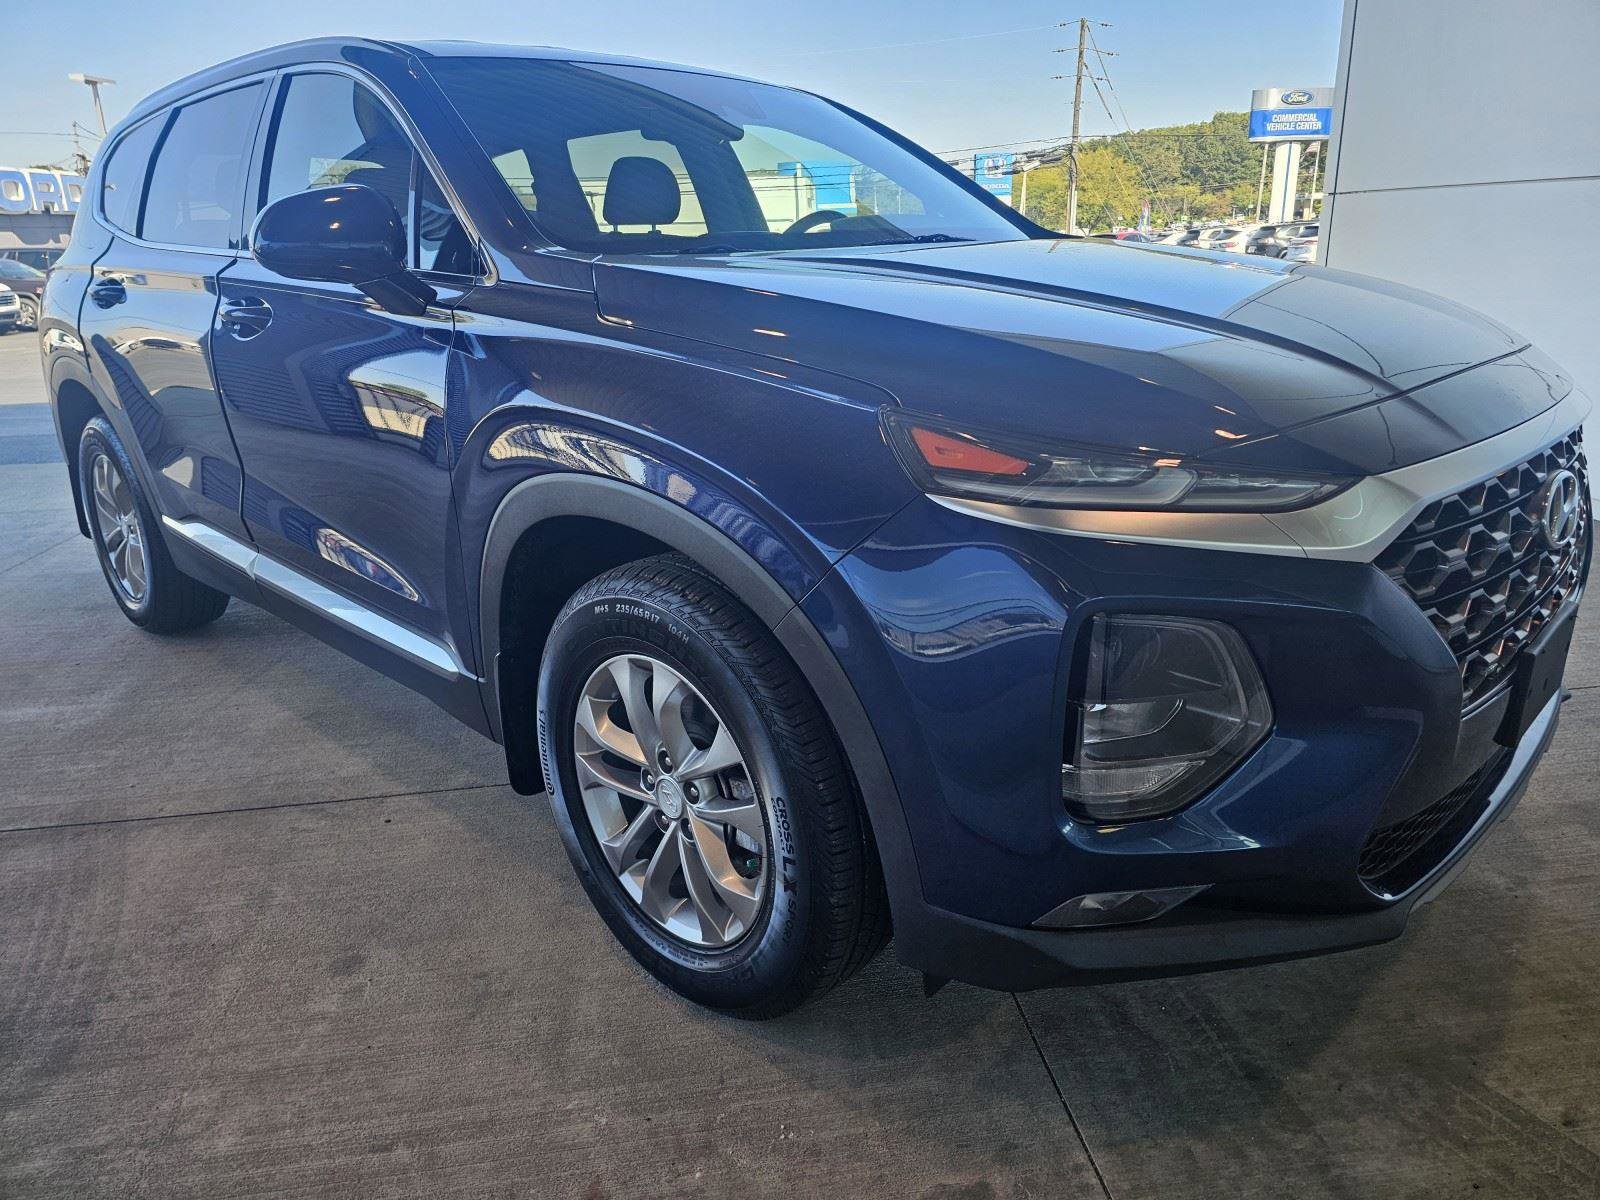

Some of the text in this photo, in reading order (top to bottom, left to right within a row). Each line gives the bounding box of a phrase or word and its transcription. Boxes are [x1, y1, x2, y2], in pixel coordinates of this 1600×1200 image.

[1288, 92, 1309, 103] Ford
[1272, 113, 1318, 122] COMMERCIAL
[1266, 121, 1322, 131] VEHICLE CENTER
[594, 604, 609, 614] M+S
[539, 718, 555, 796] Continental
[776, 796, 795, 855] CROSS
